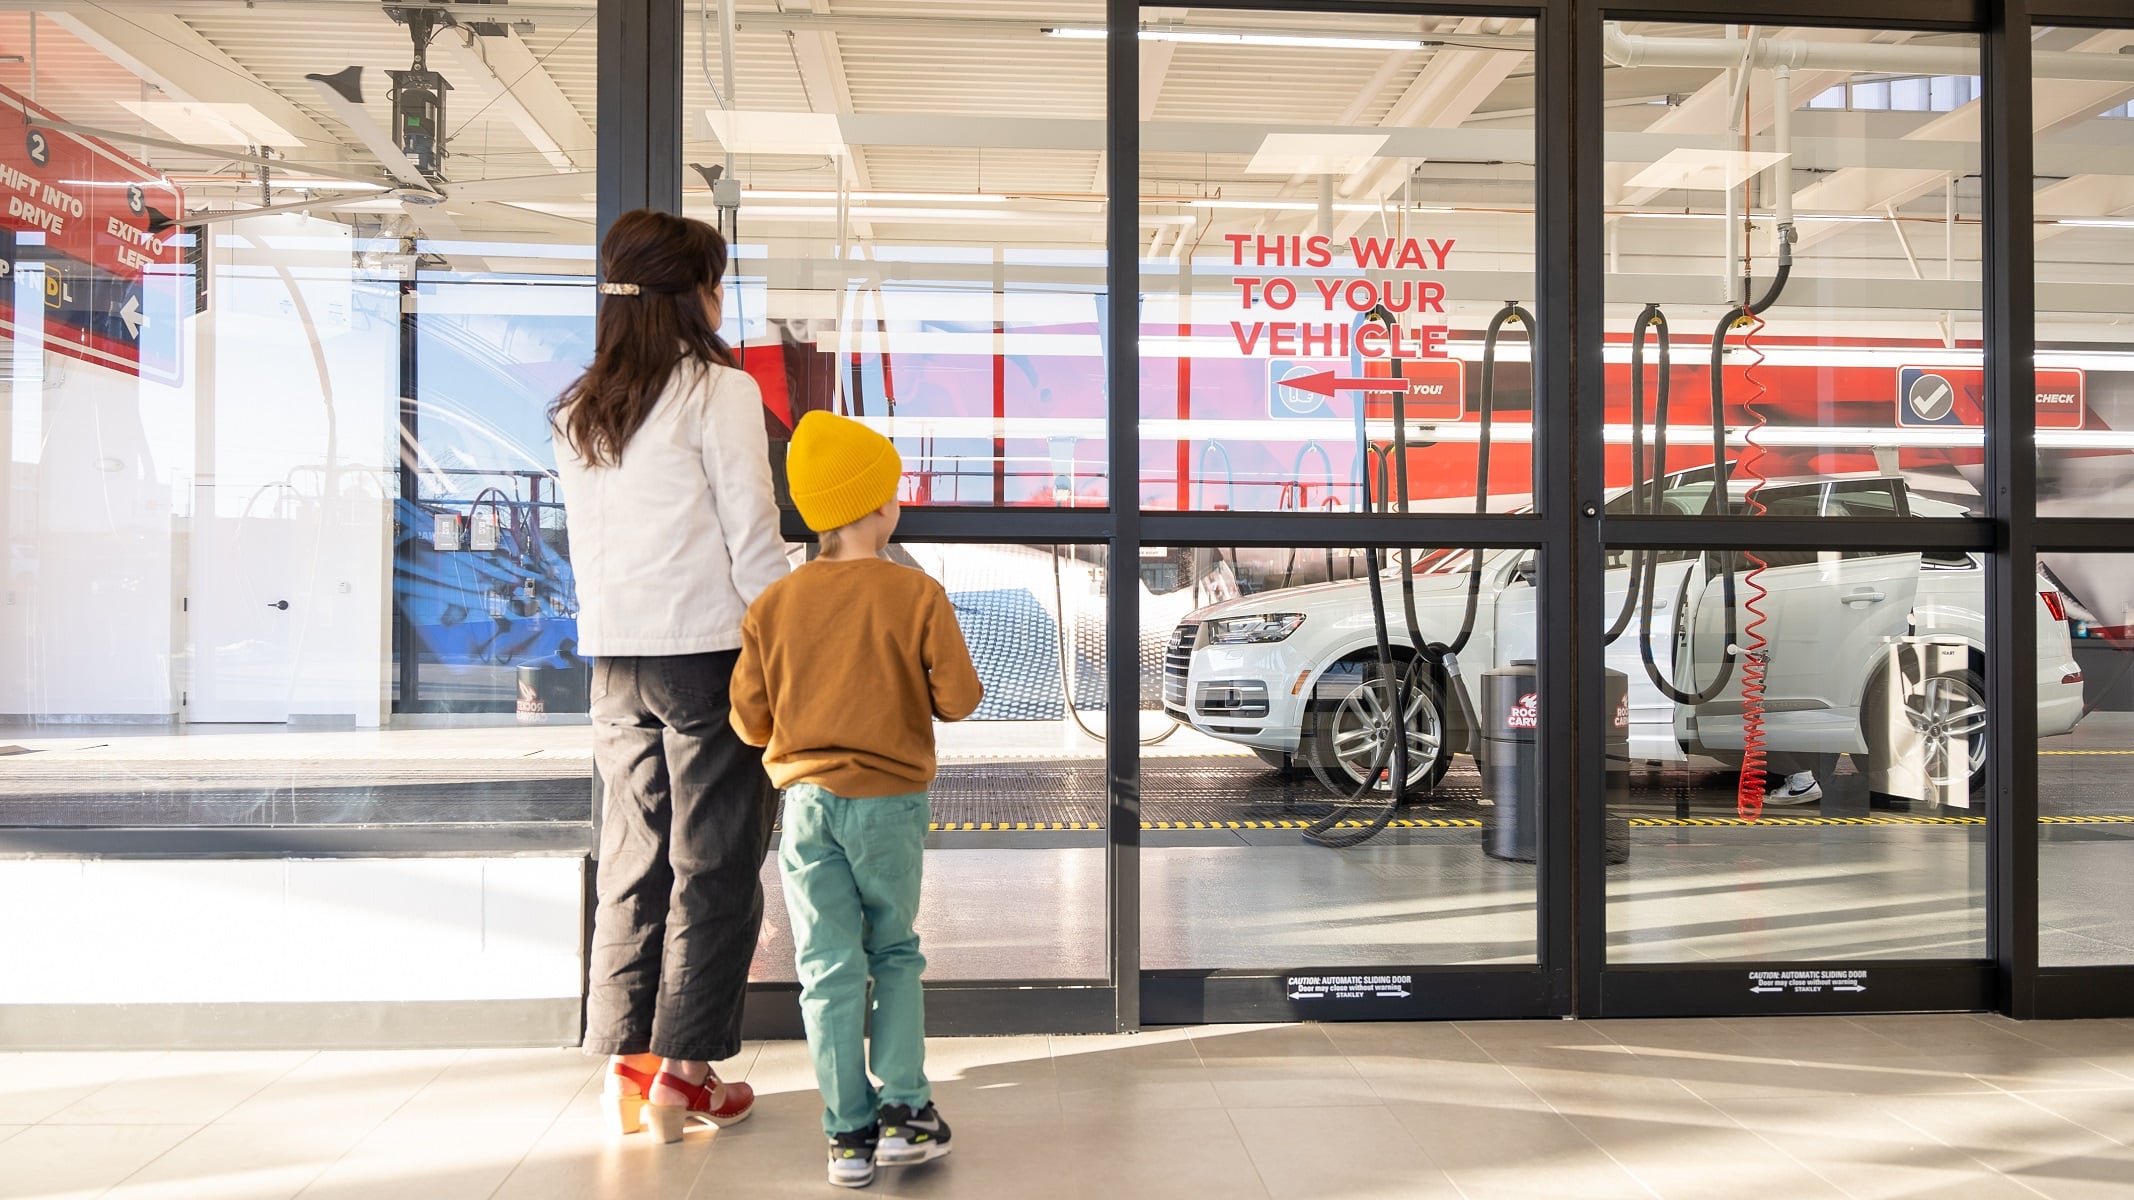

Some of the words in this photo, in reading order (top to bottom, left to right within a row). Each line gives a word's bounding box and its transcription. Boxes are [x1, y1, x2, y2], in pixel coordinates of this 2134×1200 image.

[32, 134, 45, 162] 2
[0, 163, 41, 198] HIFT
[42, 184, 83, 218] INTO
[131, 186, 142, 212] 3
[8, 197, 64, 236] DRIVE
[107, 216, 142, 245] EXIT
[143, 232, 164, 256] TO
[117, 245, 155, 273] LEFT
[1225, 234, 1332, 268] THIS
[1350, 236, 1456, 270] WAY
[1233, 277, 1298, 311] TO
[1314, 279, 1446, 313] YOUR
[1230, 321, 1449, 358] VEHICLE
[1413, 384, 1443, 396] YOU!
[2035, 393, 2075, 404] CHECK
[1512, 708, 1537, 717] ROC
[1288, 977, 1321, 985] CAUTION:
[1322, 976, 1363, 985] AUTOMATIC
[1363, 976, 1392, 984] SLIDING
[1392, 975, 1412, 984] DOOR
[1781, 971, 1820, 979] AUTOMATIC
[1848, 970, 1867, 978] DOOR
[1832, 979, 1858, 987] warning
[1298, 984, 1314, 992] Door
[1315, 985, 1329, 993] may
[1330, 984, 1348, 992] close
[1375, 984, 1402, 992] warning
